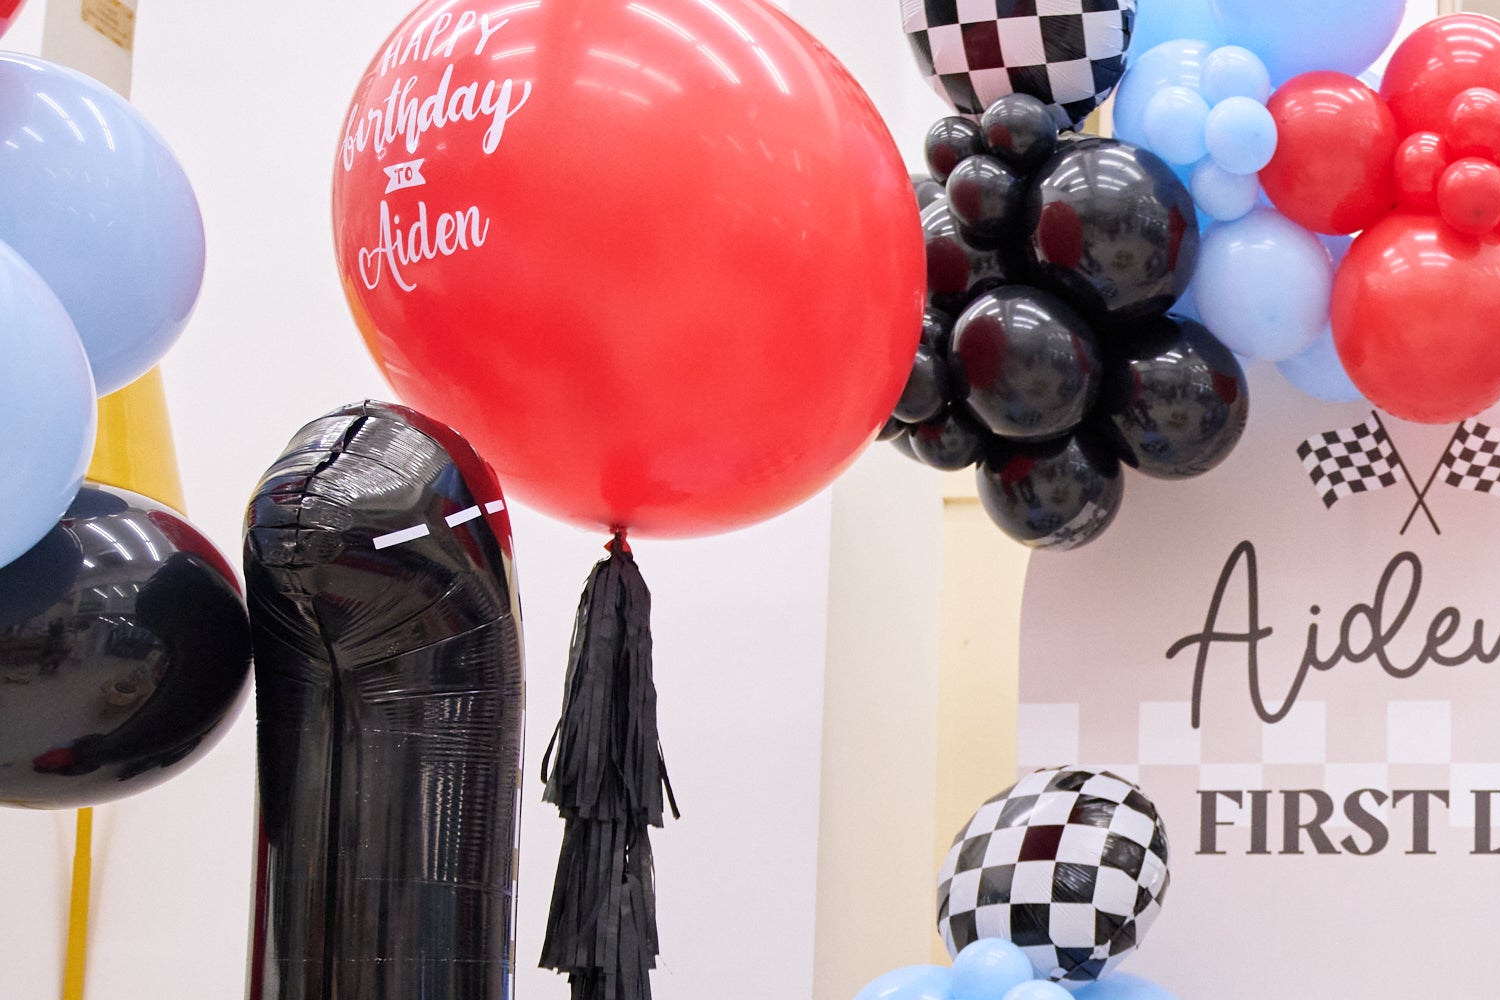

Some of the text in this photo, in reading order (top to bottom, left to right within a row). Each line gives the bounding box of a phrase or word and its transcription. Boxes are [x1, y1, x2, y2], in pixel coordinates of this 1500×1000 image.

[380, 10, 510, 78] HAPPY
[342, 62, 533, 173] birthday
[393, 166, 413, 185] TO
[358, 199, 490, 292] Aiden
[1194, 787, 1450, 856] FIRST
